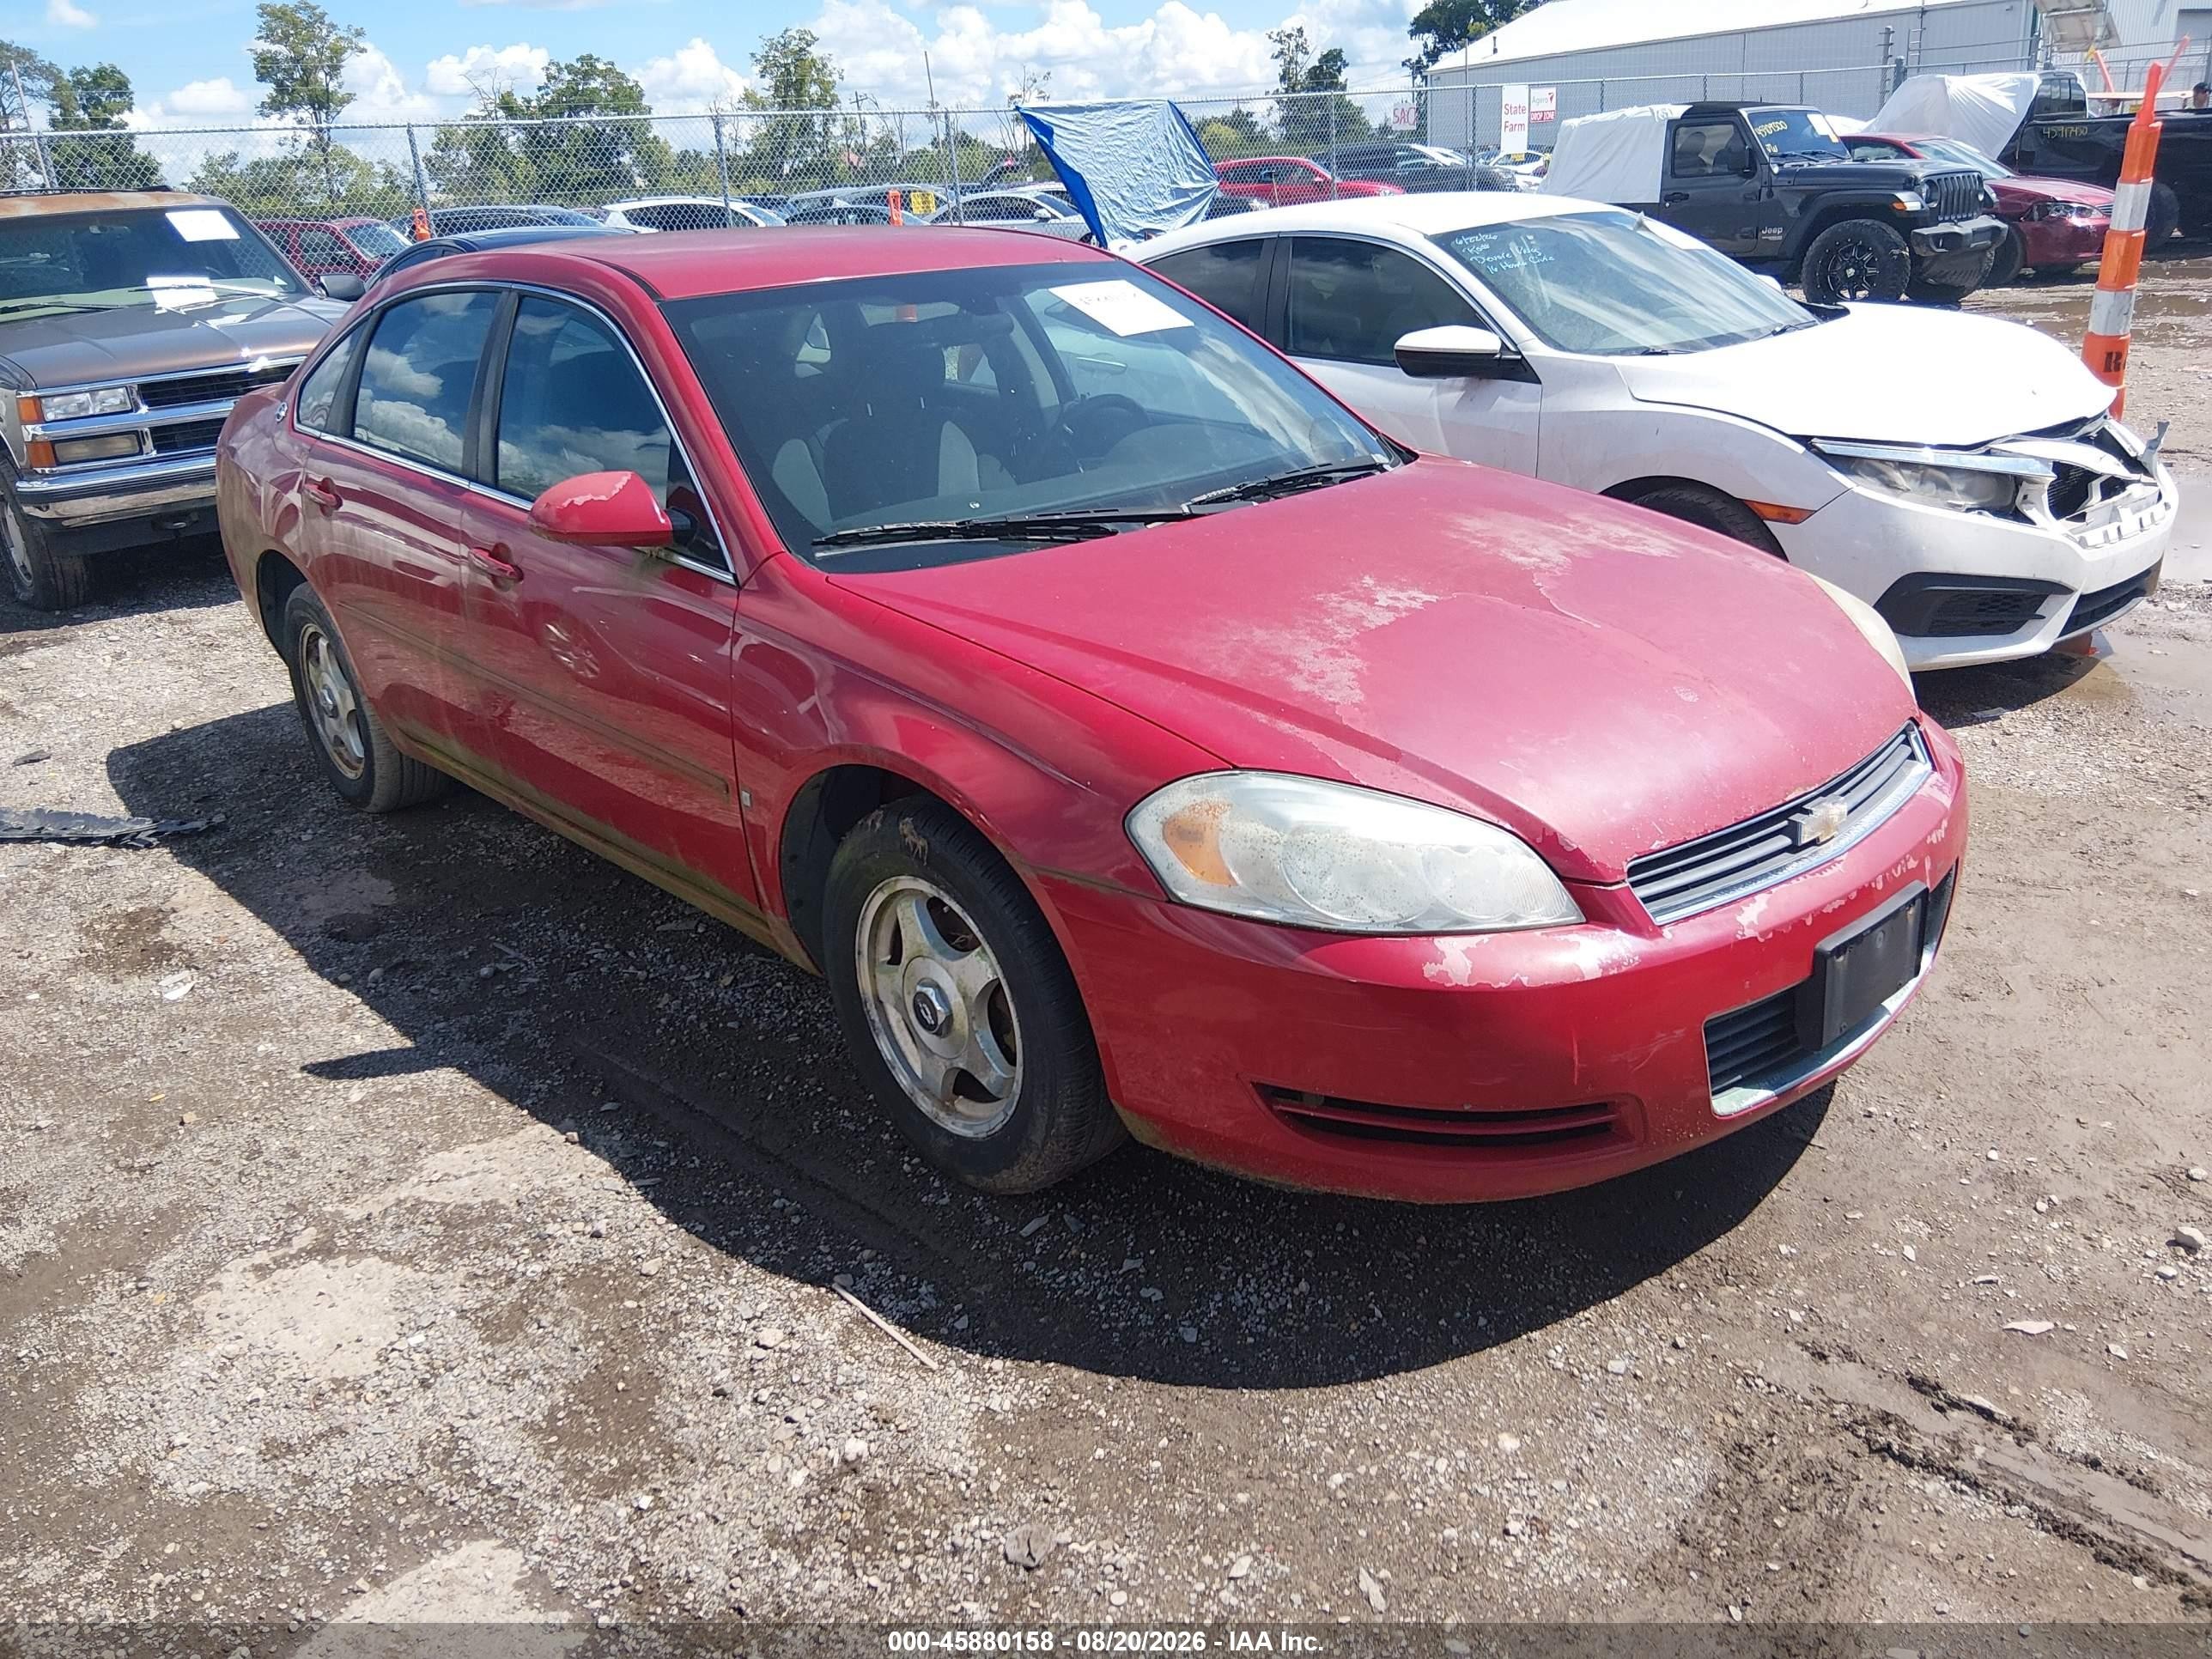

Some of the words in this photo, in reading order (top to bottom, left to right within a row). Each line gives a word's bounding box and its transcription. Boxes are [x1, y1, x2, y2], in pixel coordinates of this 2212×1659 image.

[1504, 103, 1527, 115] State
[1504, 121, 1526, 133] Farm
[1761, 226, 1784, 234] Jeep
